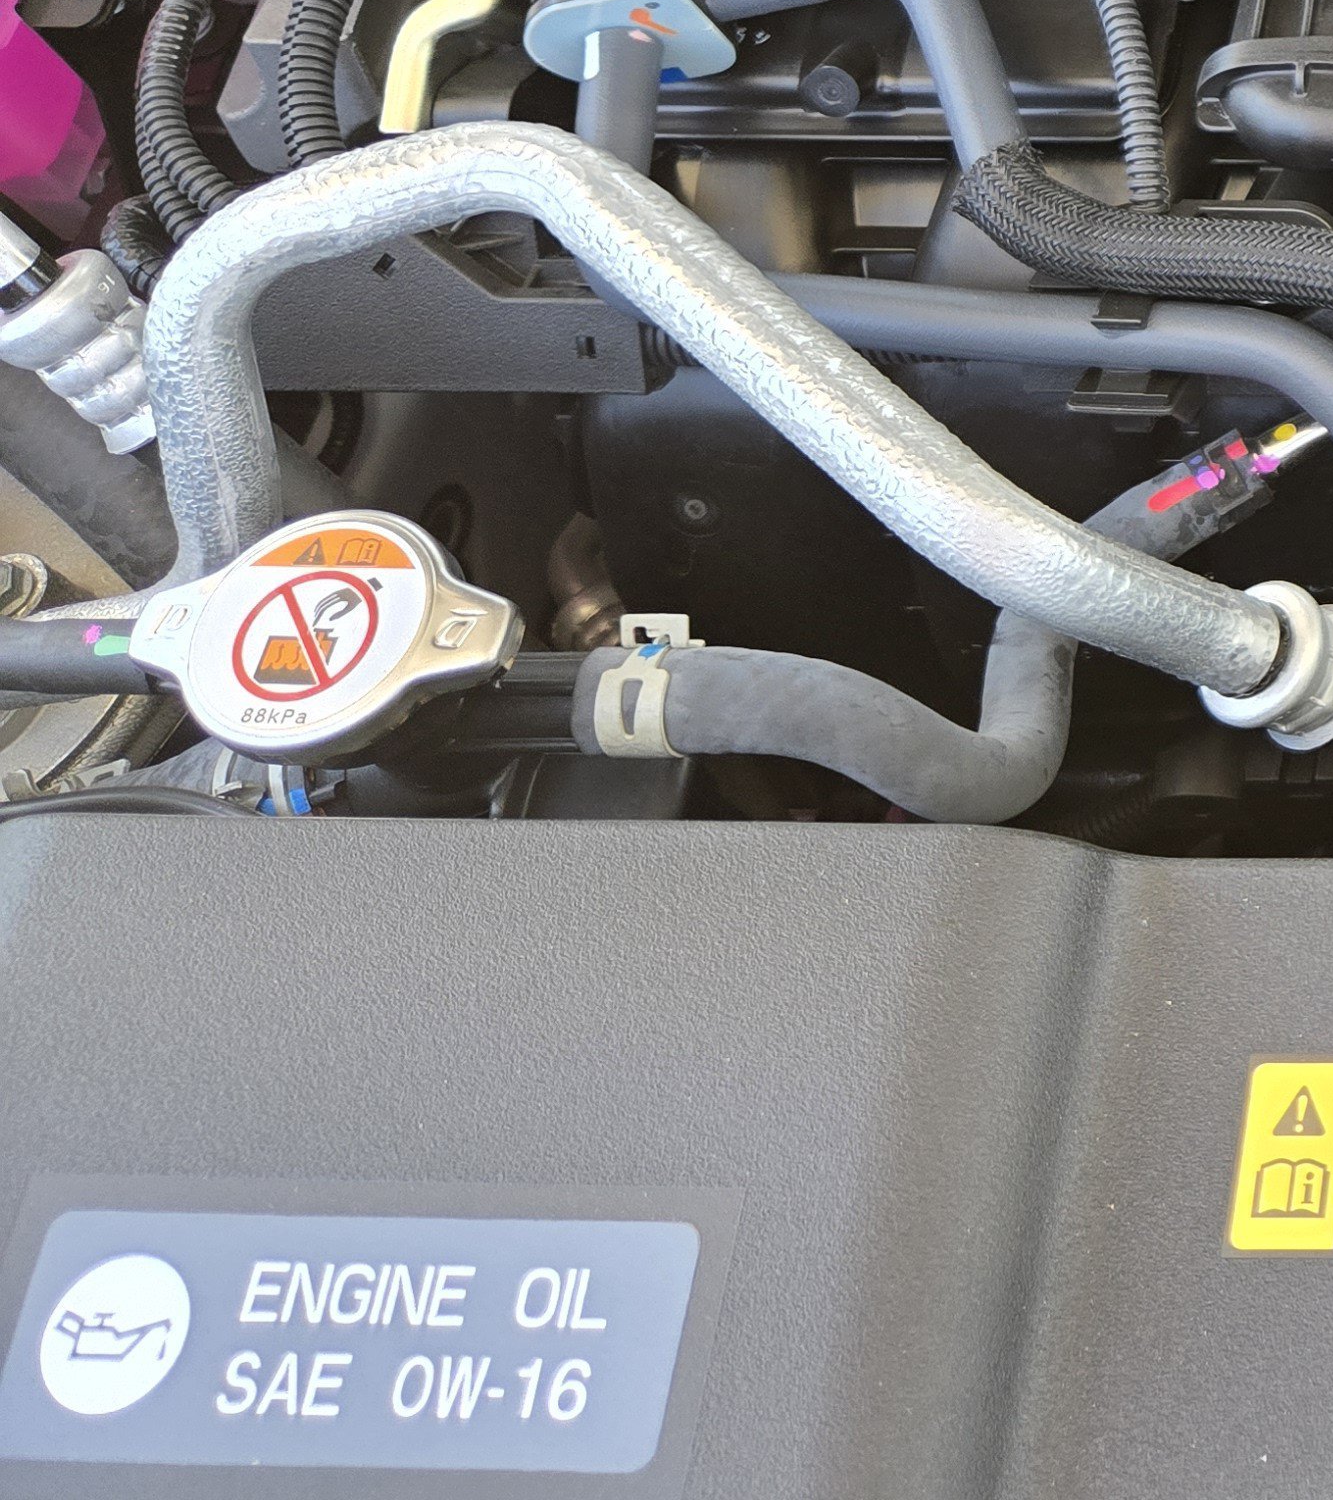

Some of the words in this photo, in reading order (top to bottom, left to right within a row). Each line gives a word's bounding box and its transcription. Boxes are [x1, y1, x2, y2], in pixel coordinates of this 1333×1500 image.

[239, 707, 308, 726] 88kPa
[239, 1260, 477, 1329] ENGINE
[514, 1266, 608, 1332] OIL
[216, 1352, 352, 1419] SAE
[390, 1356, 592, 1422] 0W-16
